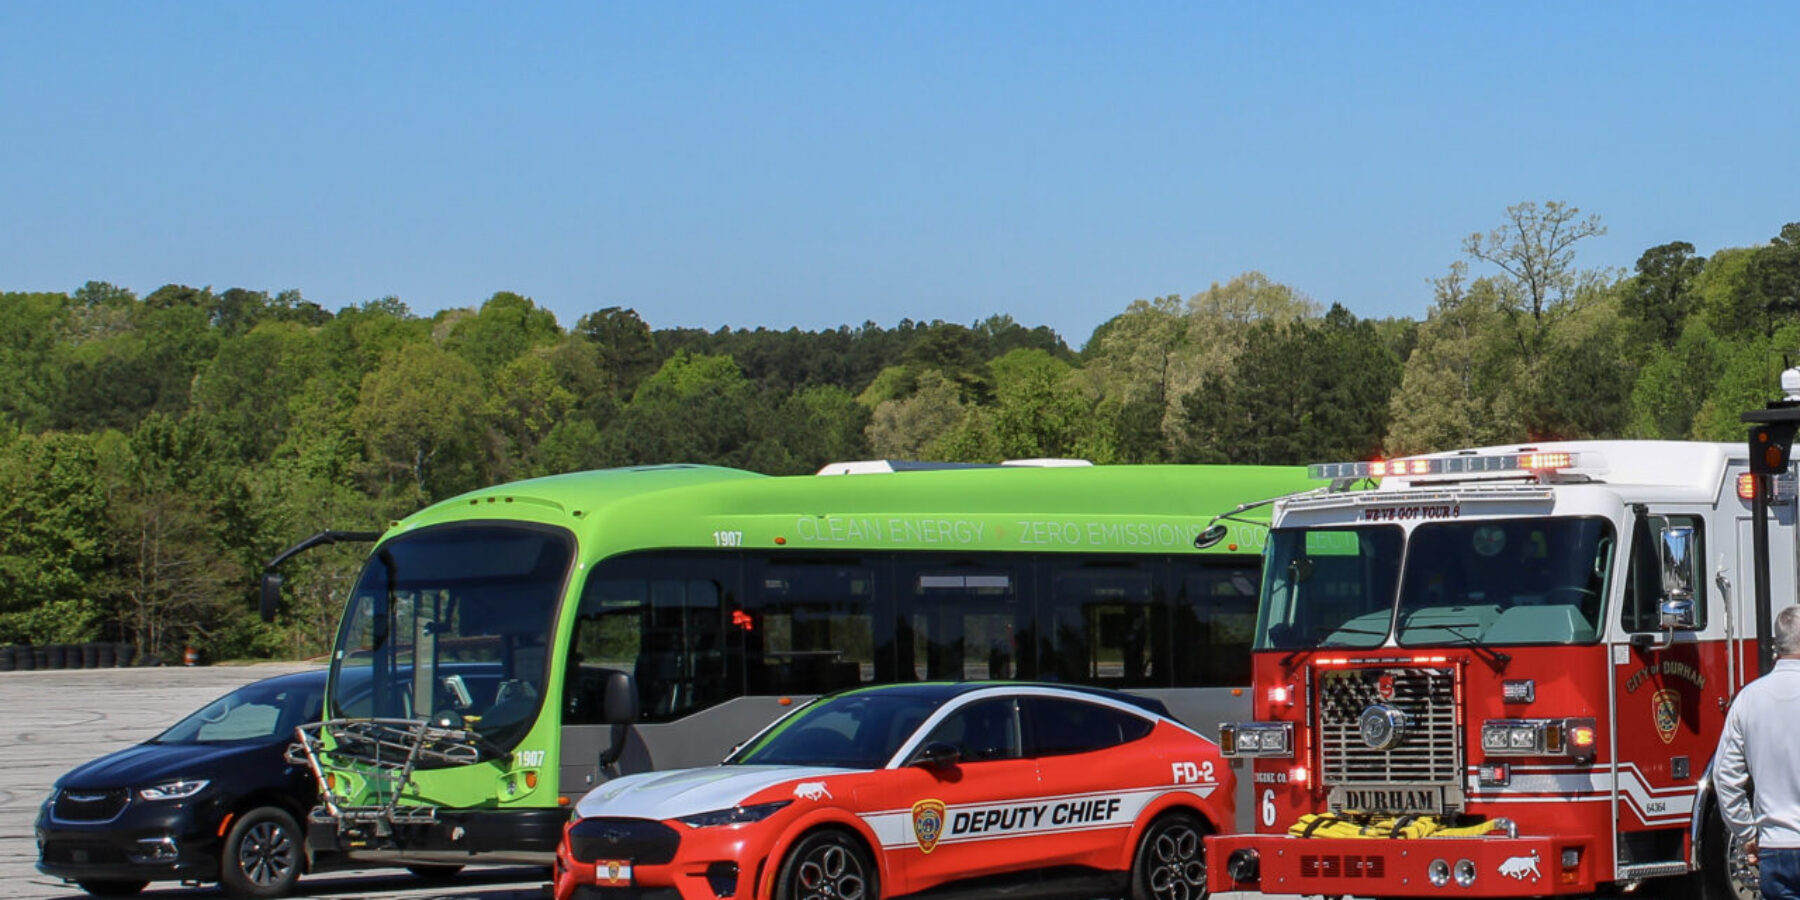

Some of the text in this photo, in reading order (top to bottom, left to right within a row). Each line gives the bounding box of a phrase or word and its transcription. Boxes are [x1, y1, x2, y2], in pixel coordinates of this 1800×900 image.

[1398, 506, 1419, 520] GOT
[1422, 505, 1450, 518] YOUR
[713, 531, 742, 547] 1907
[796, 517, 882, 541] CLEAN
[887, 518, 985, 543] ENERGY
[1016, 521, 1081, 544] ZERO
[1625, 667, 1649, 693] CITY
[1662, 660, 1707, 690] DURHAM
[516, 750, 545, 767] 1907
[1171, 761, 1215, 784] FD-2
[1262, 788, 1276, 827] 6
[1346, 790, 1433, 810] DURHAM
[951, 798, 1122, 835] DEPUTY CHIEF
